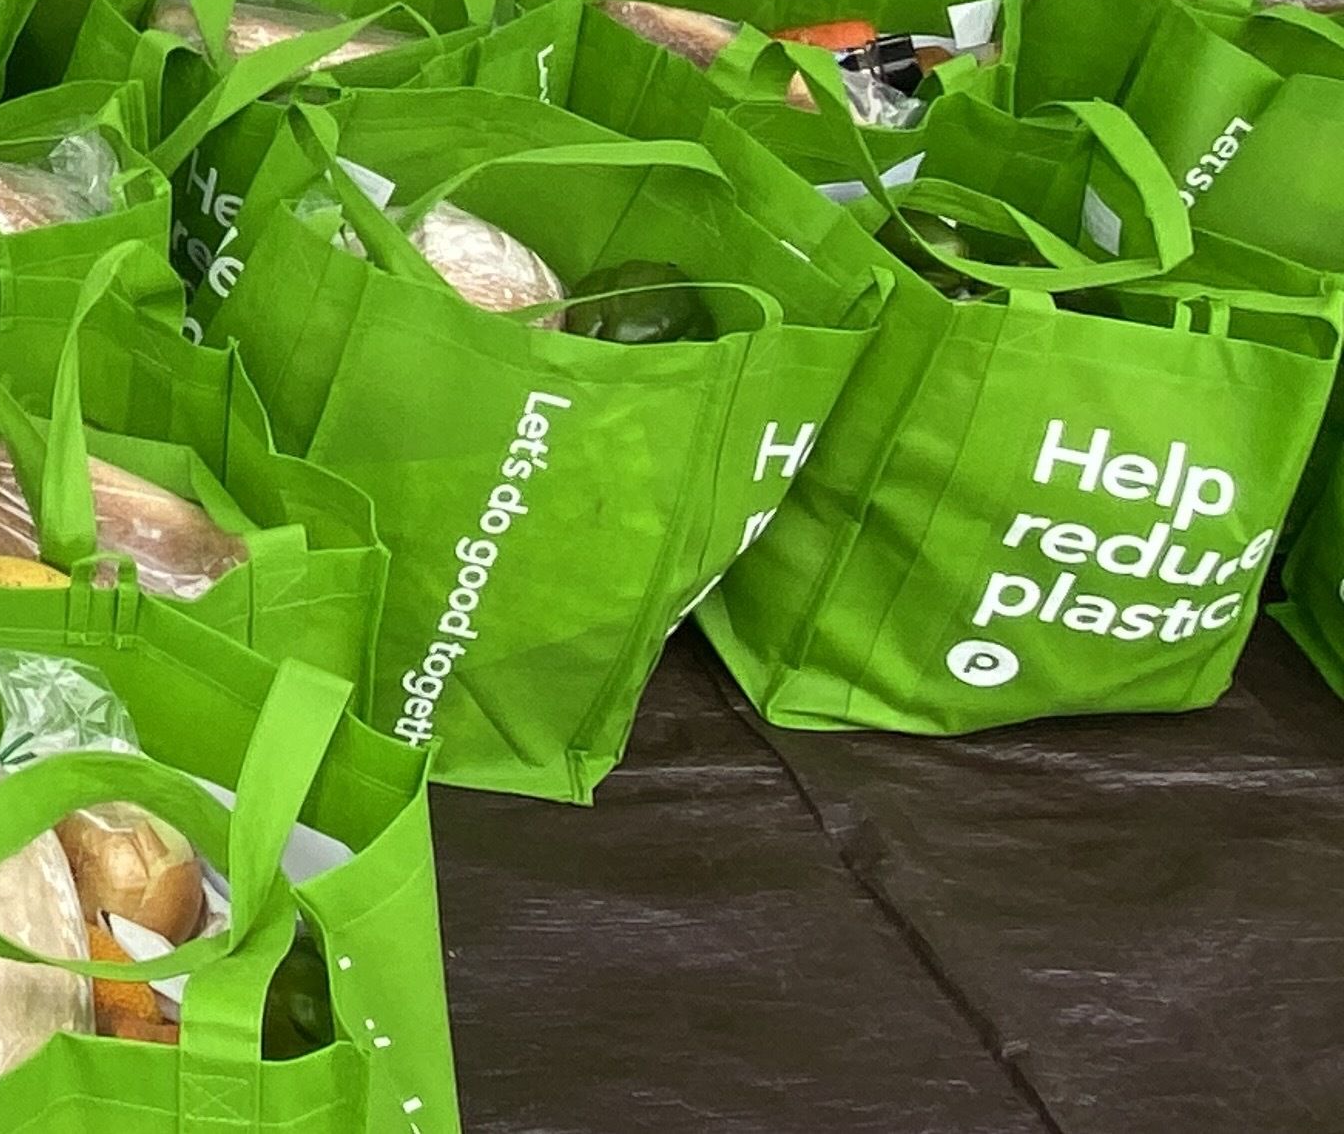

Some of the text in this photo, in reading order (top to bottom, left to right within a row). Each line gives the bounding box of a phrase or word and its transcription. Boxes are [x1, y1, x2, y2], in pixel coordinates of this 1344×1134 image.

[501, 392, 572, 480] Let's
[1033, 418, 1236, 532] Help
[479, 483, 529, 534] do
[437, 536, 508, 640] good
